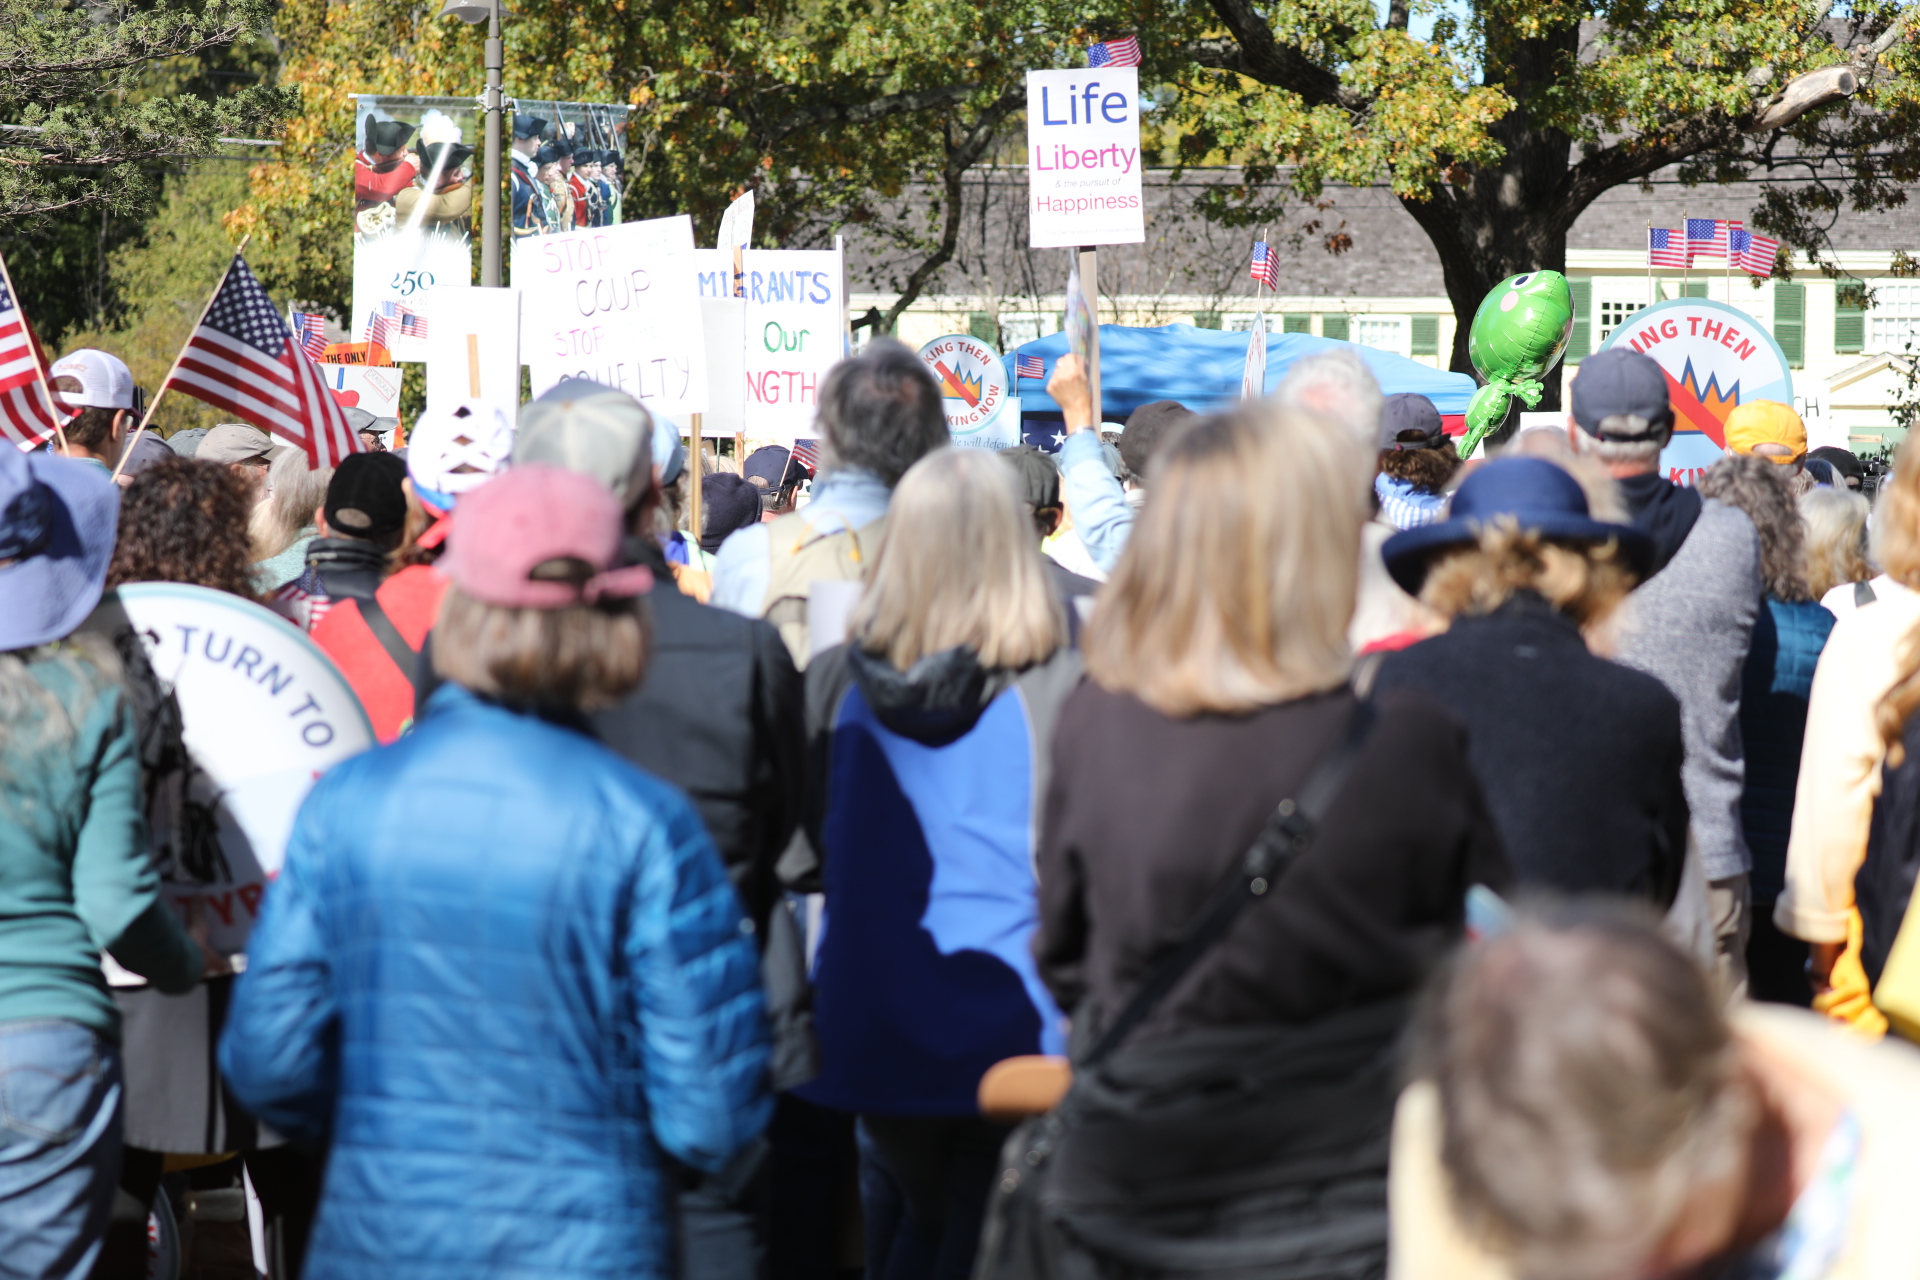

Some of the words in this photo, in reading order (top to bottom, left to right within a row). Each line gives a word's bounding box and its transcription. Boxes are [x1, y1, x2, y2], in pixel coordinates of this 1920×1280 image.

[1042, 82, 1128, 126] Life
[1036, 143, 1136, 174] Liberty
[1055, 179, 1061, 188] &
[1063, 178, 1077, 188] the
[1079, 178, 1110, 189] pursuit
[1112, 177, 1122, 187] of
[1037, 194, 1139, 215] Happiness
[543, 235, 610, 273] STOP
[390, 270, 435, 296] 250
[576, 269, 650, 317] COUP
[554, 326, 605, 356] STOP
[764, 321, 811, 353] Our
[1687, 316, 1757, 361] THEN
[325, 354, 342, 364] THE
[344, 351, 366, 363] ONLY
[923, 342, 954, 365] KING
[957, 341, 991, 365] THEN
[559, 356, 690, 400] ELTY
[946, 412, 979, 426] KING
[978, 384, 1000, 415] NOW
[963, 437, 981, 448] will
[983, 437, 1014, 450] defend
[176, 624, 294, 697] TURN
[289, 692, 335, 748] TO
